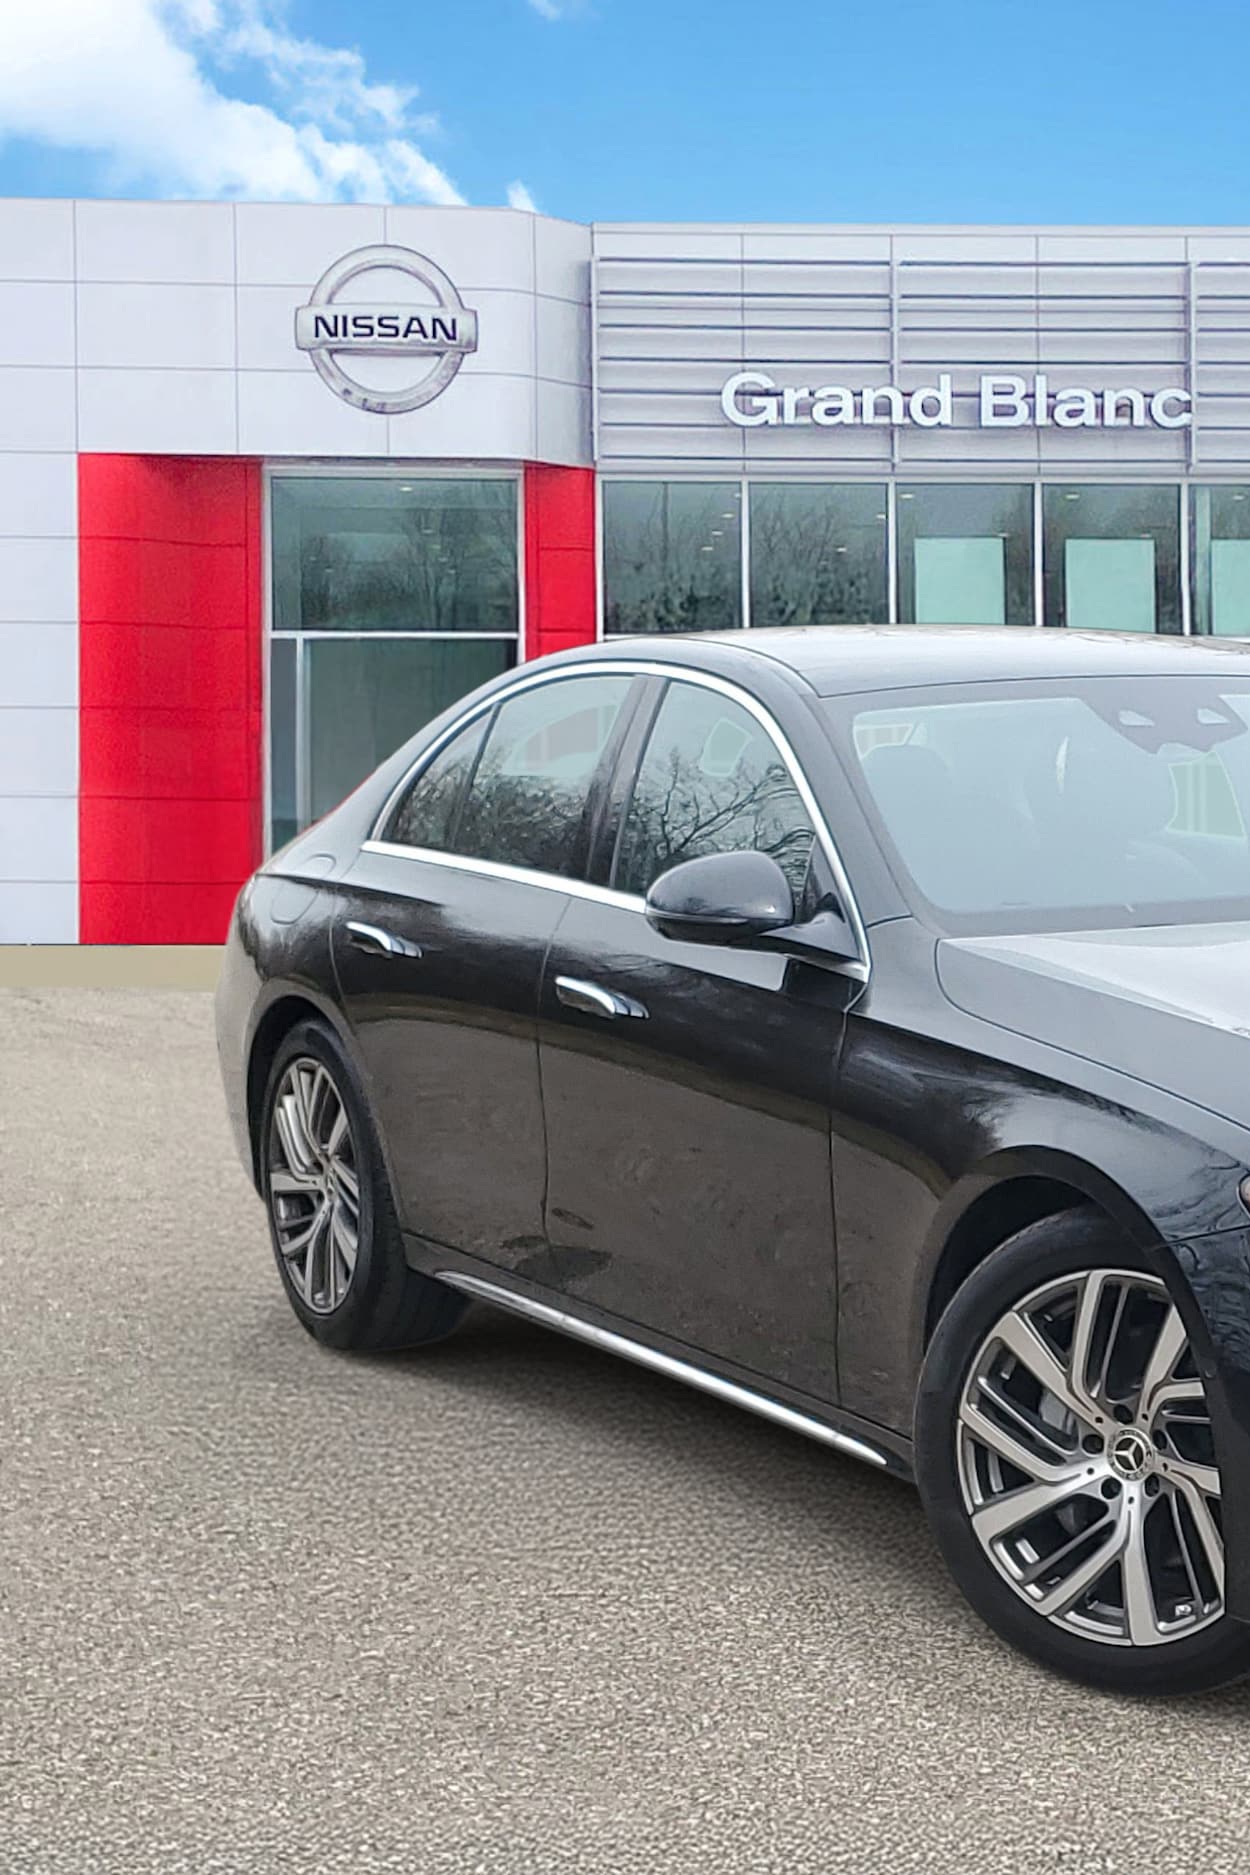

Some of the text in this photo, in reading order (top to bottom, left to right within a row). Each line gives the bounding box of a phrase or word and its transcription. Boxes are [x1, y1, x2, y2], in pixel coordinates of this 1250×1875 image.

[314, 315, 458, 341] NISSAN
[720, 371, 1193, 428] Grand Blanc
